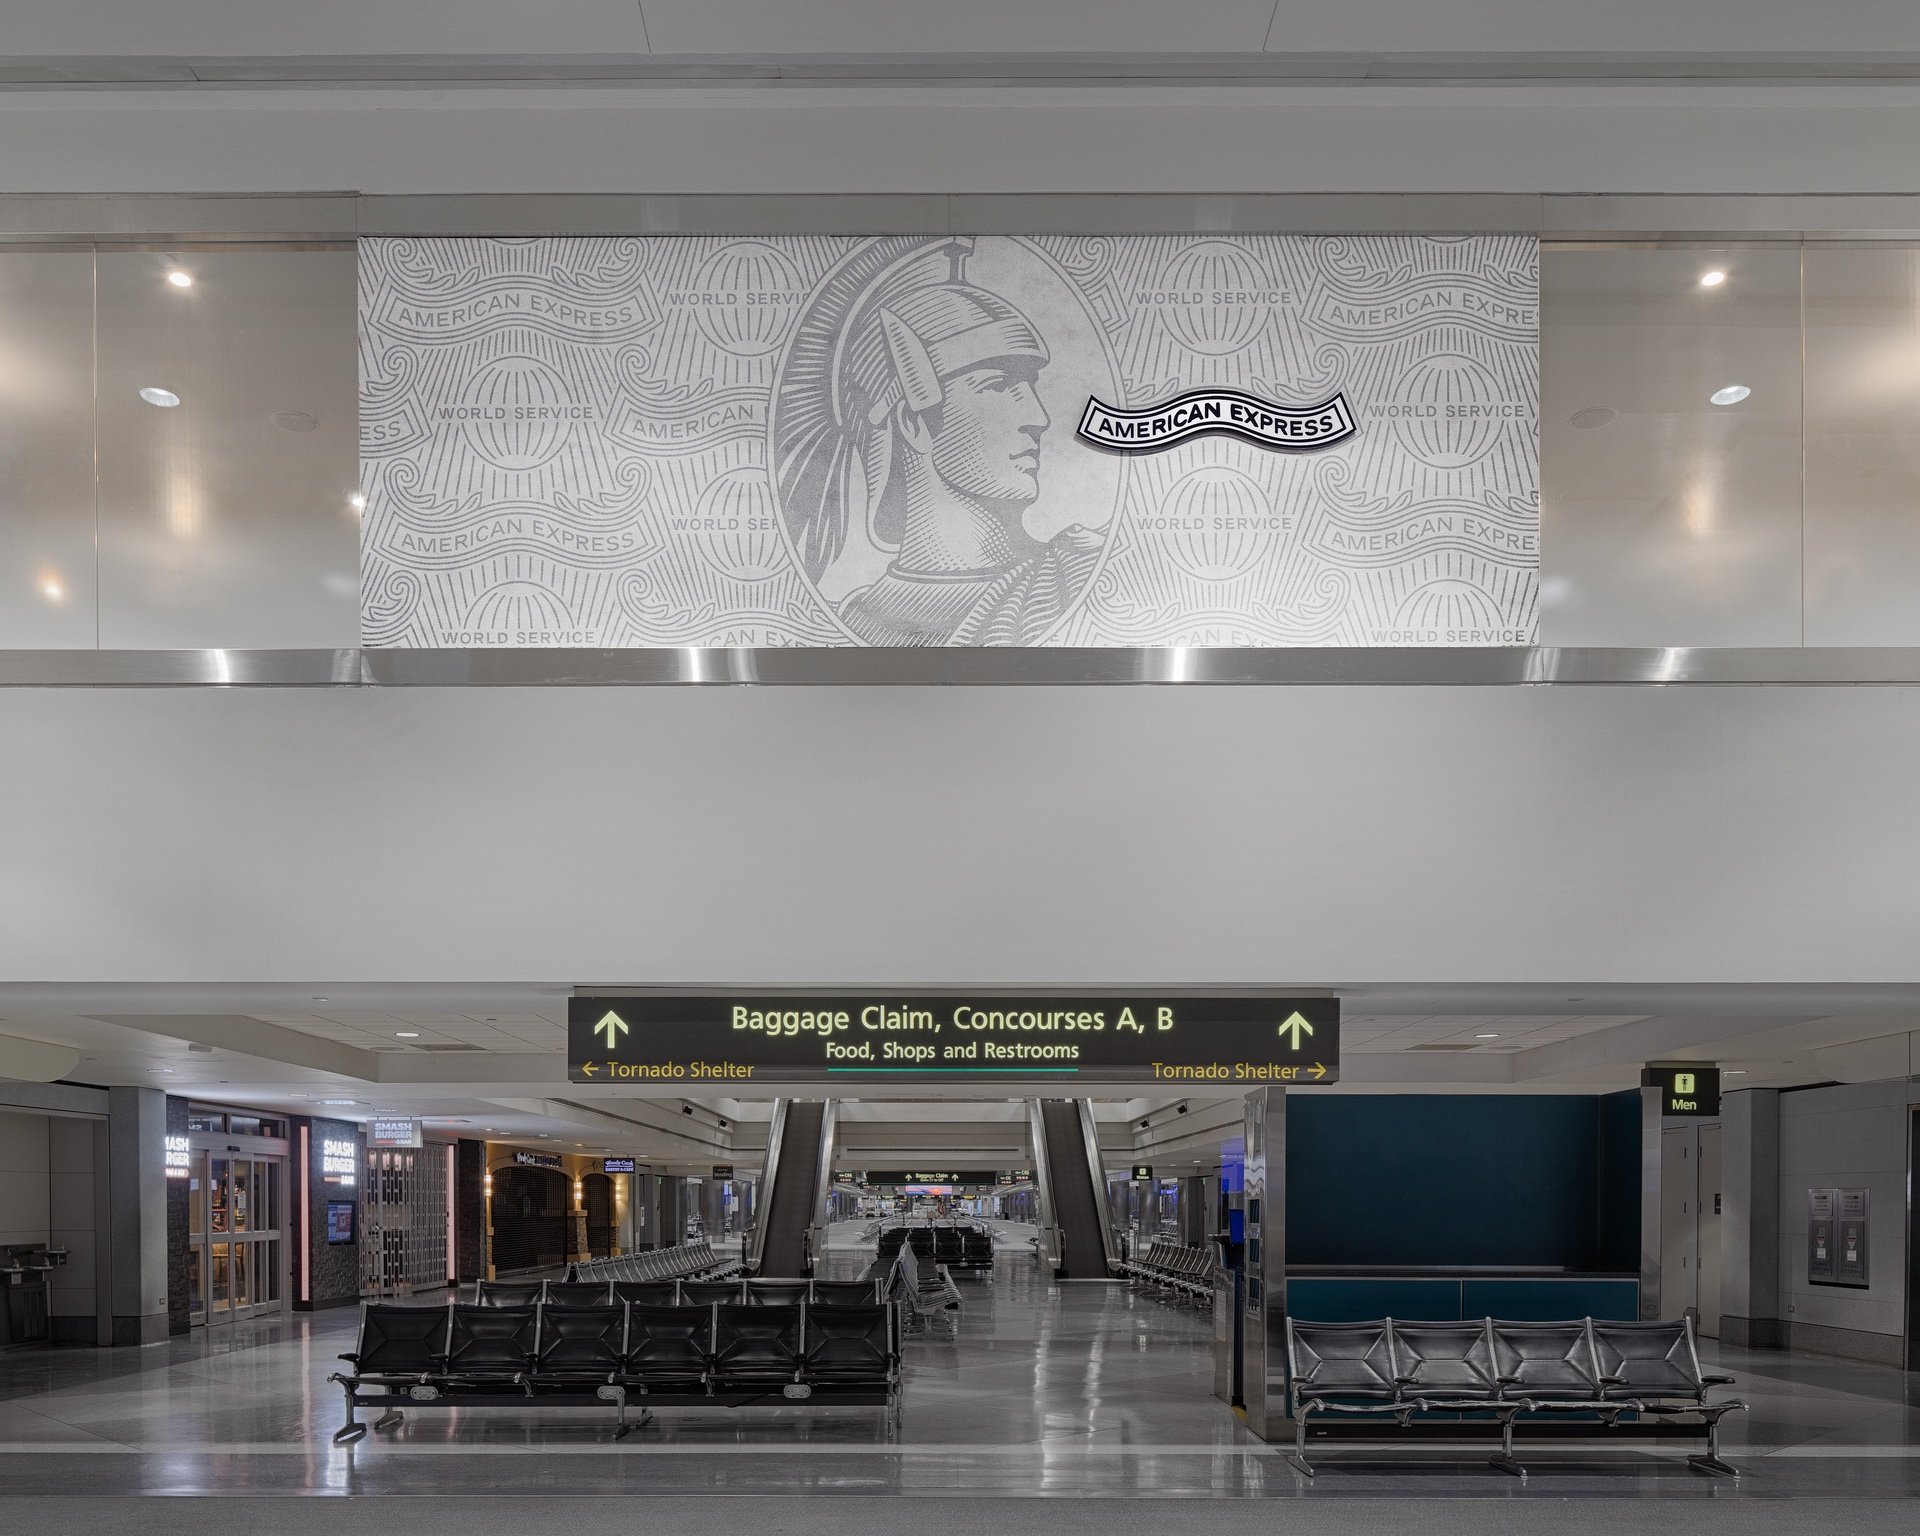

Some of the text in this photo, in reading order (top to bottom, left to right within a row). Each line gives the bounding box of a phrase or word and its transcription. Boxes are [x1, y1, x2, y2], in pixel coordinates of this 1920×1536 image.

[669, 292, 738, 306] WORLD
[1135, 291, 1292, 305] WORLD SERVICE
[399, 293, 633, 328] AMERICAN EXPRESS
[1330, 291, 1538, 326] AMERICAN EXPRE
[438, 406, 594, 420] WORLD SERVICE
[1369, 404, 1525, 418] WORLD SERVICE
[632, 404, 754, 440] AMERICAN
[1098, 401, 1334, 439] AMERICAN EXPRESS
[671, 518, 740, 531] WORLD
[1137, 517, 1293, 531] WORLD SERVICE
[401, 518, 635, 554] AMERICAN EXPRESS
[1330, 516, 1539, 552] AMERICAN EXPRE
[442, 630, 596, 645] WORLD SERVICE
[1370, 629, 1526, 643] WORLD SERVICE
[731, 1005, 1174, 1036] Baggage Claim, Concourses A, B
[825, 1041, 1080, 1063] Food, Shops and Restrooms
[607, 1061, 755, 1078] Tornado Shelter
[1151, 1062, 1300, 1079] Tornado Shelter
[1672, 1099, 1697, 1110] Men
[374, 1122, 412, 1131] SMASH
[374, 1130, 412, 1139] BURGER
[323, 1139, 355, 1158] SMASH
[165, 1151, 190, 1167] RGER
[323, 1156, 355, 1174] BURGER
